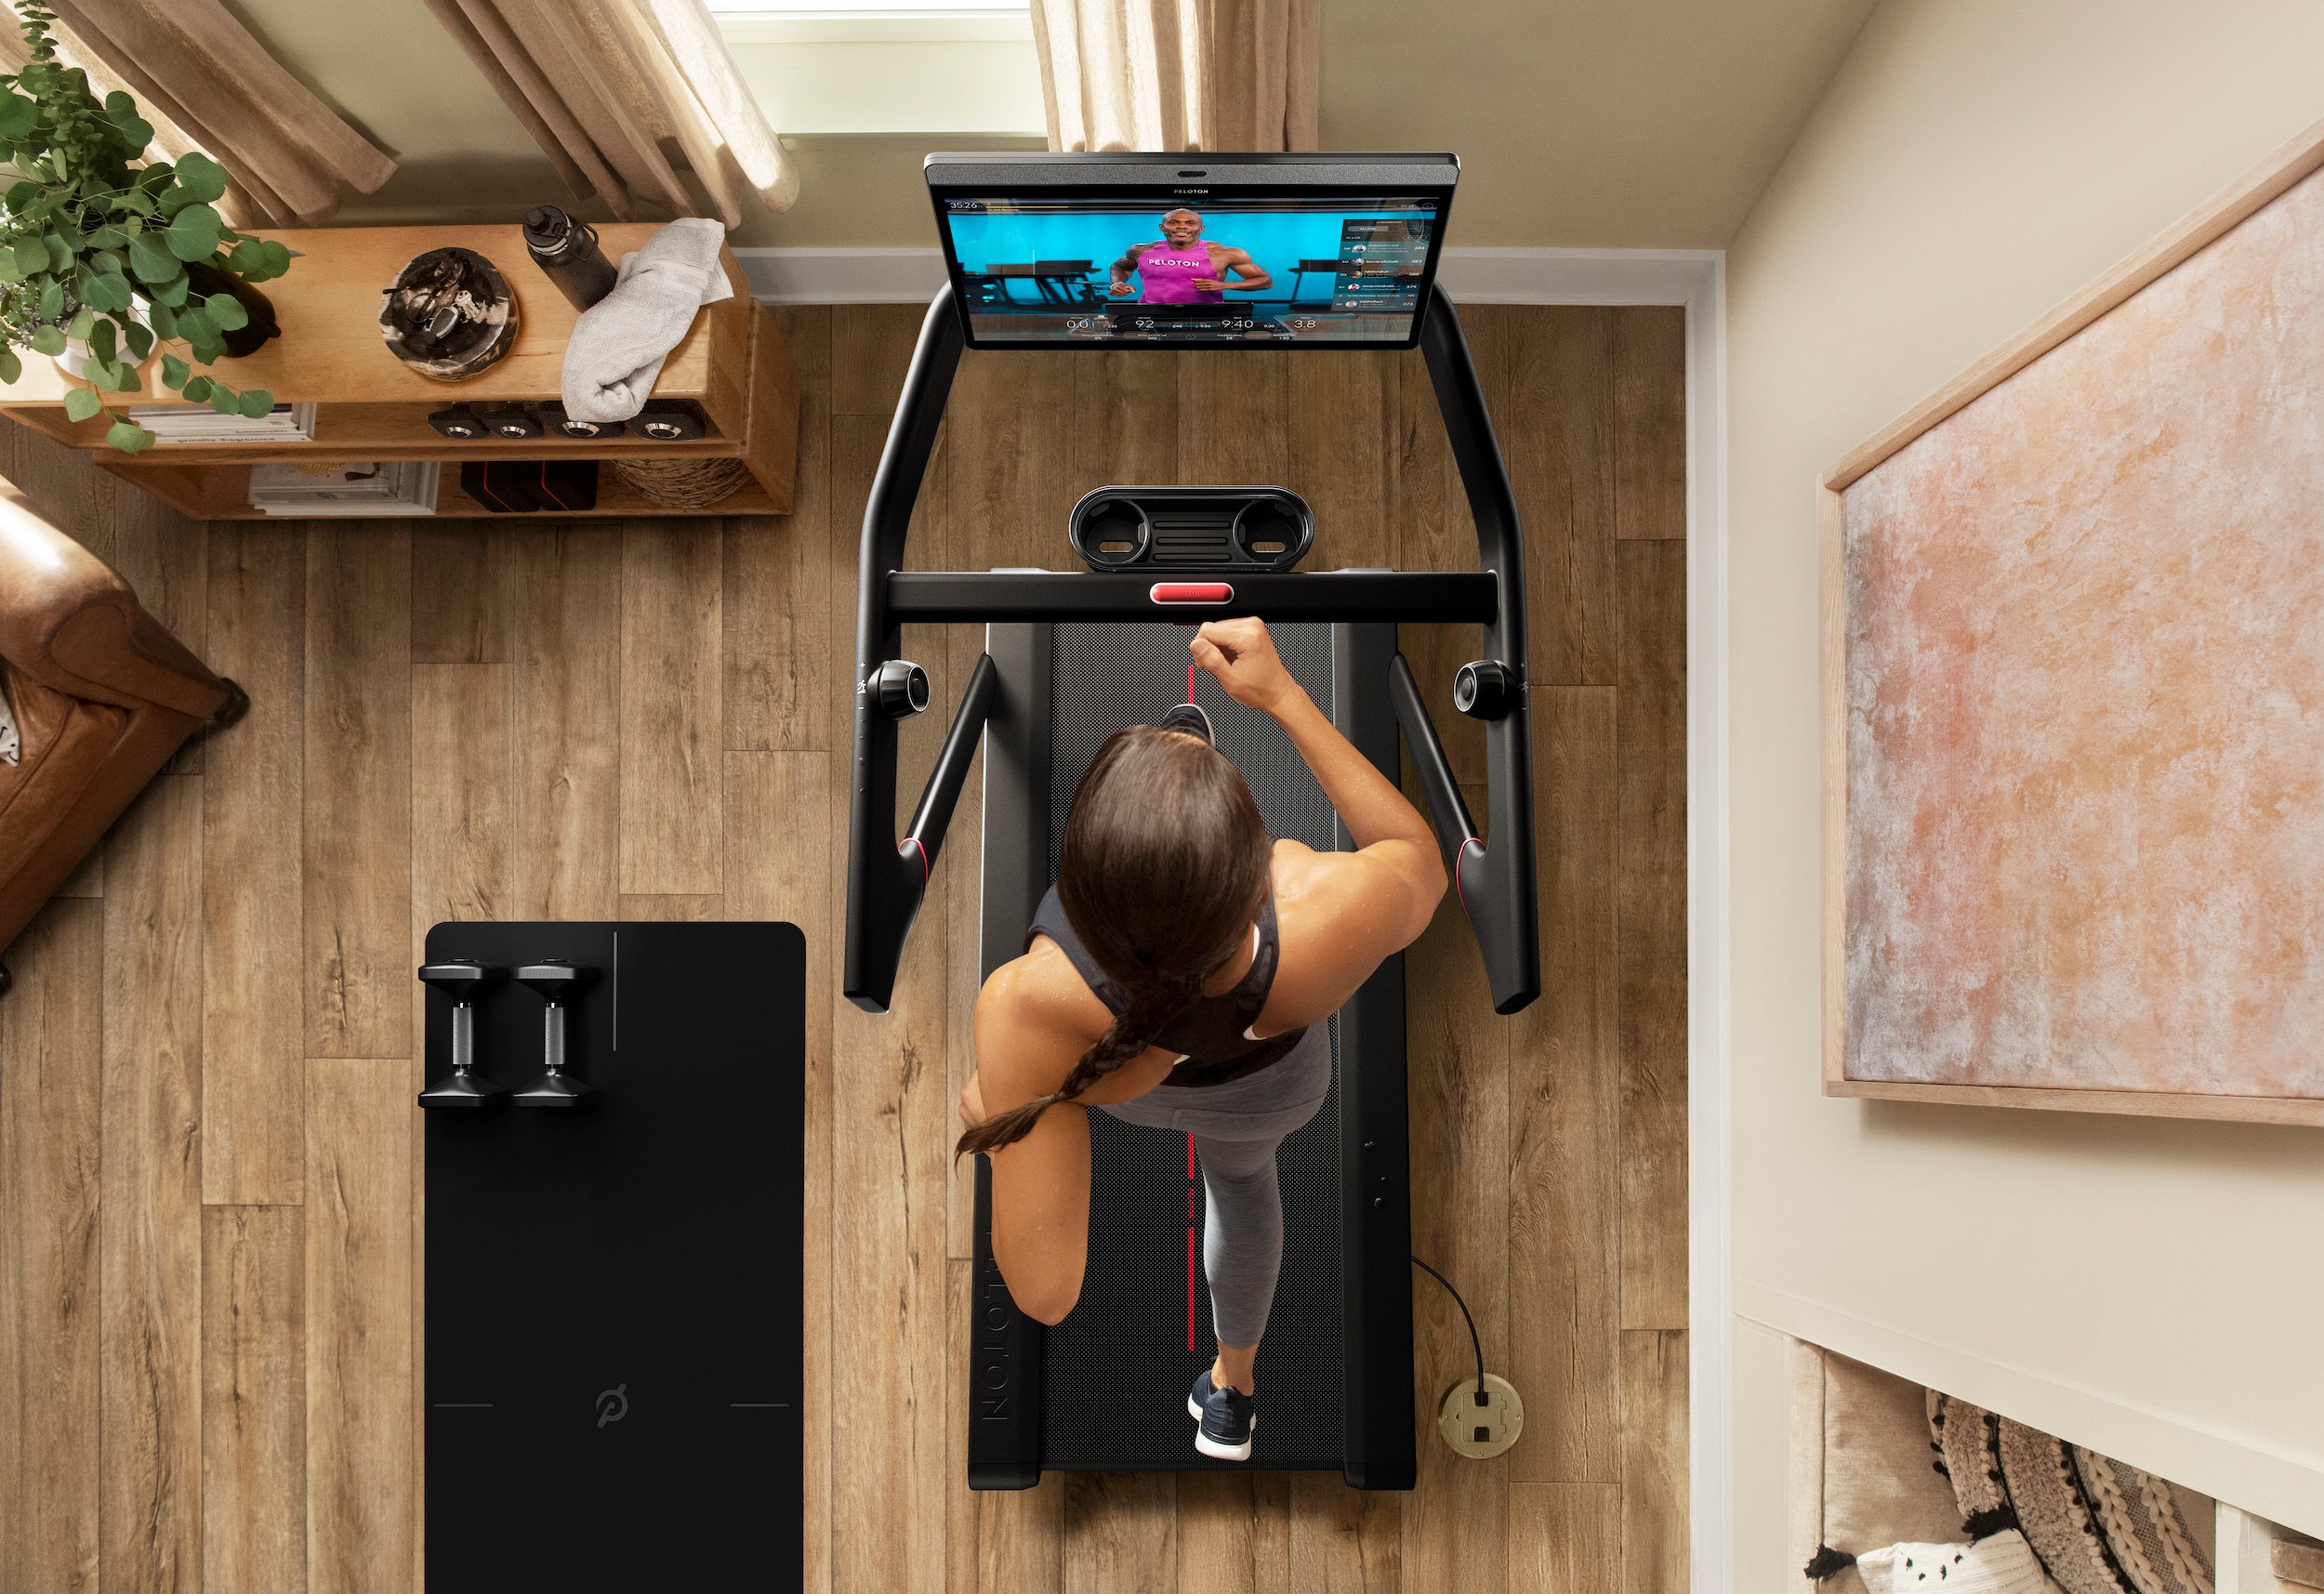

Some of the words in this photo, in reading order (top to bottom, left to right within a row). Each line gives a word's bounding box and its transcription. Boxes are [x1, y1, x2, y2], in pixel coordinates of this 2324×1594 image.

[1135, 320, 1155, 328] 92
[1221, 320, 1254, 328] 9:40
[1294, 320, 1317, 328] 3.8
[982, 1231, 1010, 1420] ELOTON
